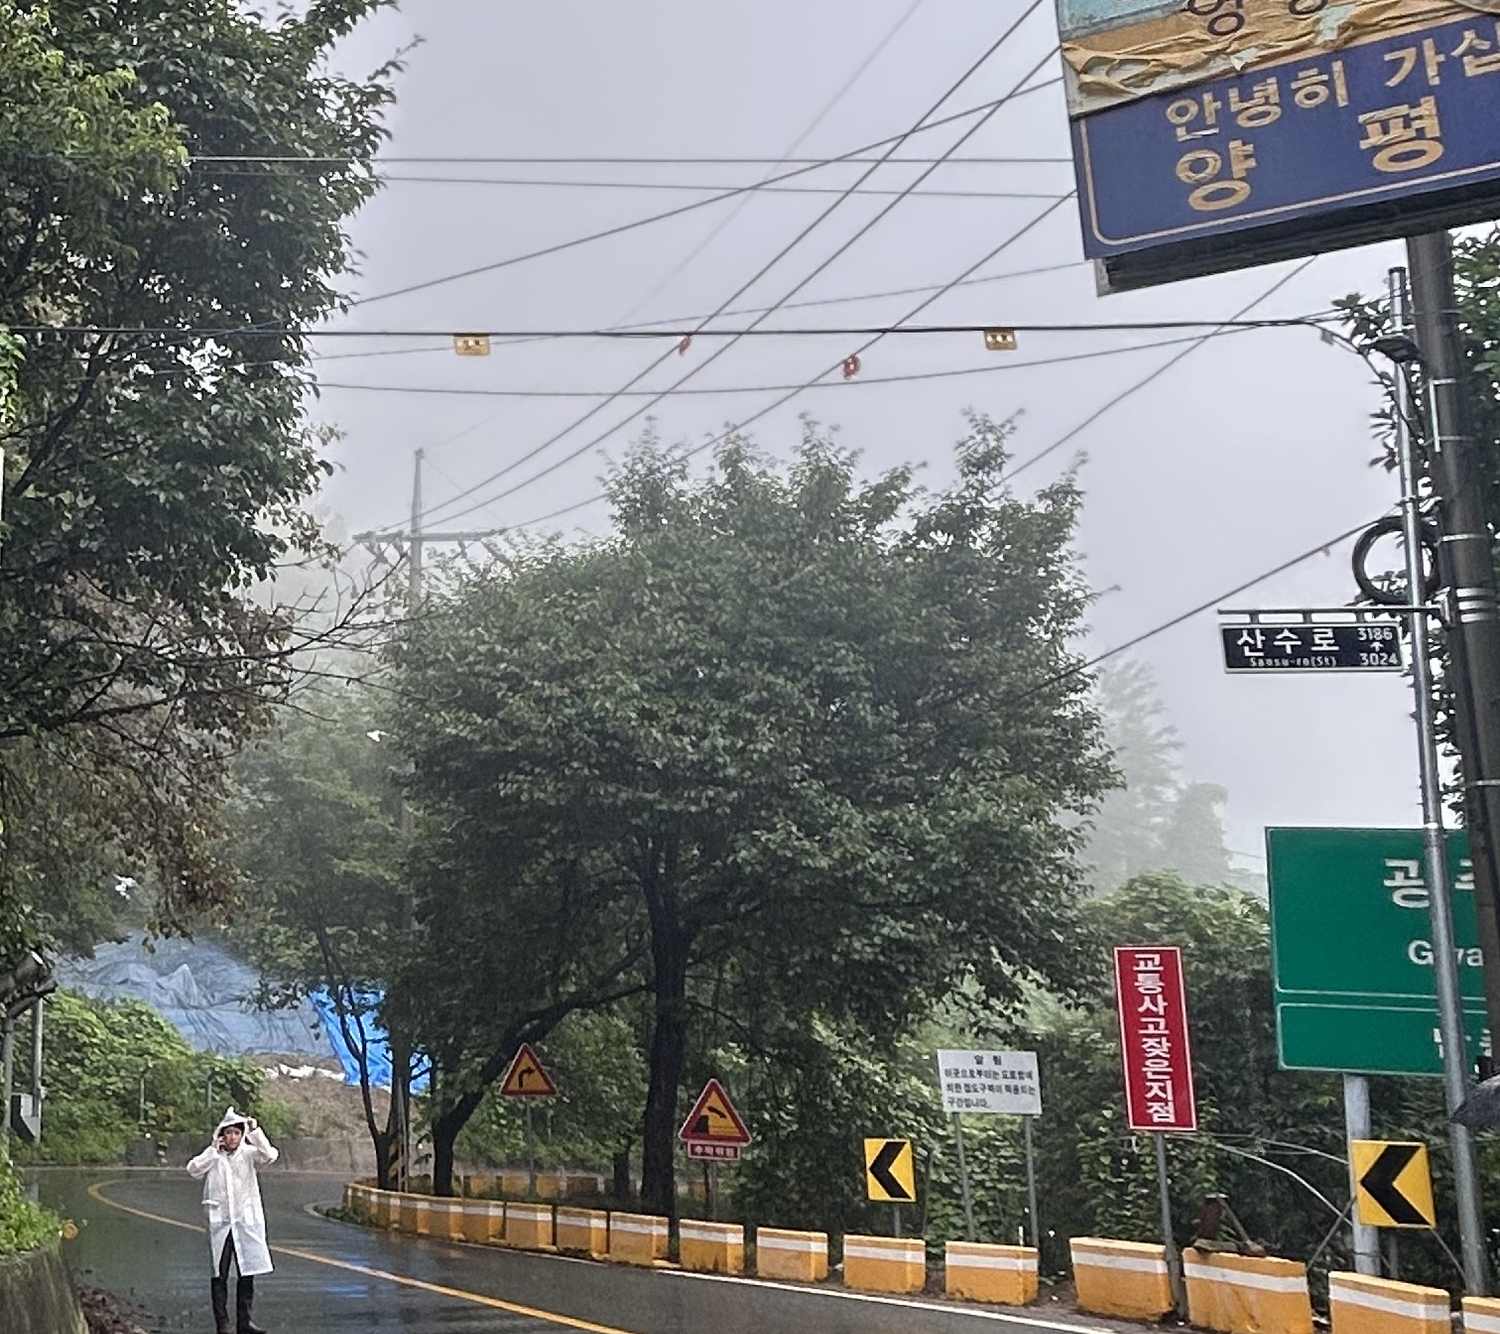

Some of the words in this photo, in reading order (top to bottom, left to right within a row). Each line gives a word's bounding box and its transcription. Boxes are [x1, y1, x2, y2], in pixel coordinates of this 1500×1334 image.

[1166, 60, 1349, 142] 안녕히
[1237, 628, 1340, 657] 산수로
[1357, 627, 1393, 641] 3186
[1359, 652, 1399, 666] 3024
[1133, 953, 1177, 1124] 교통사고잦은지점
